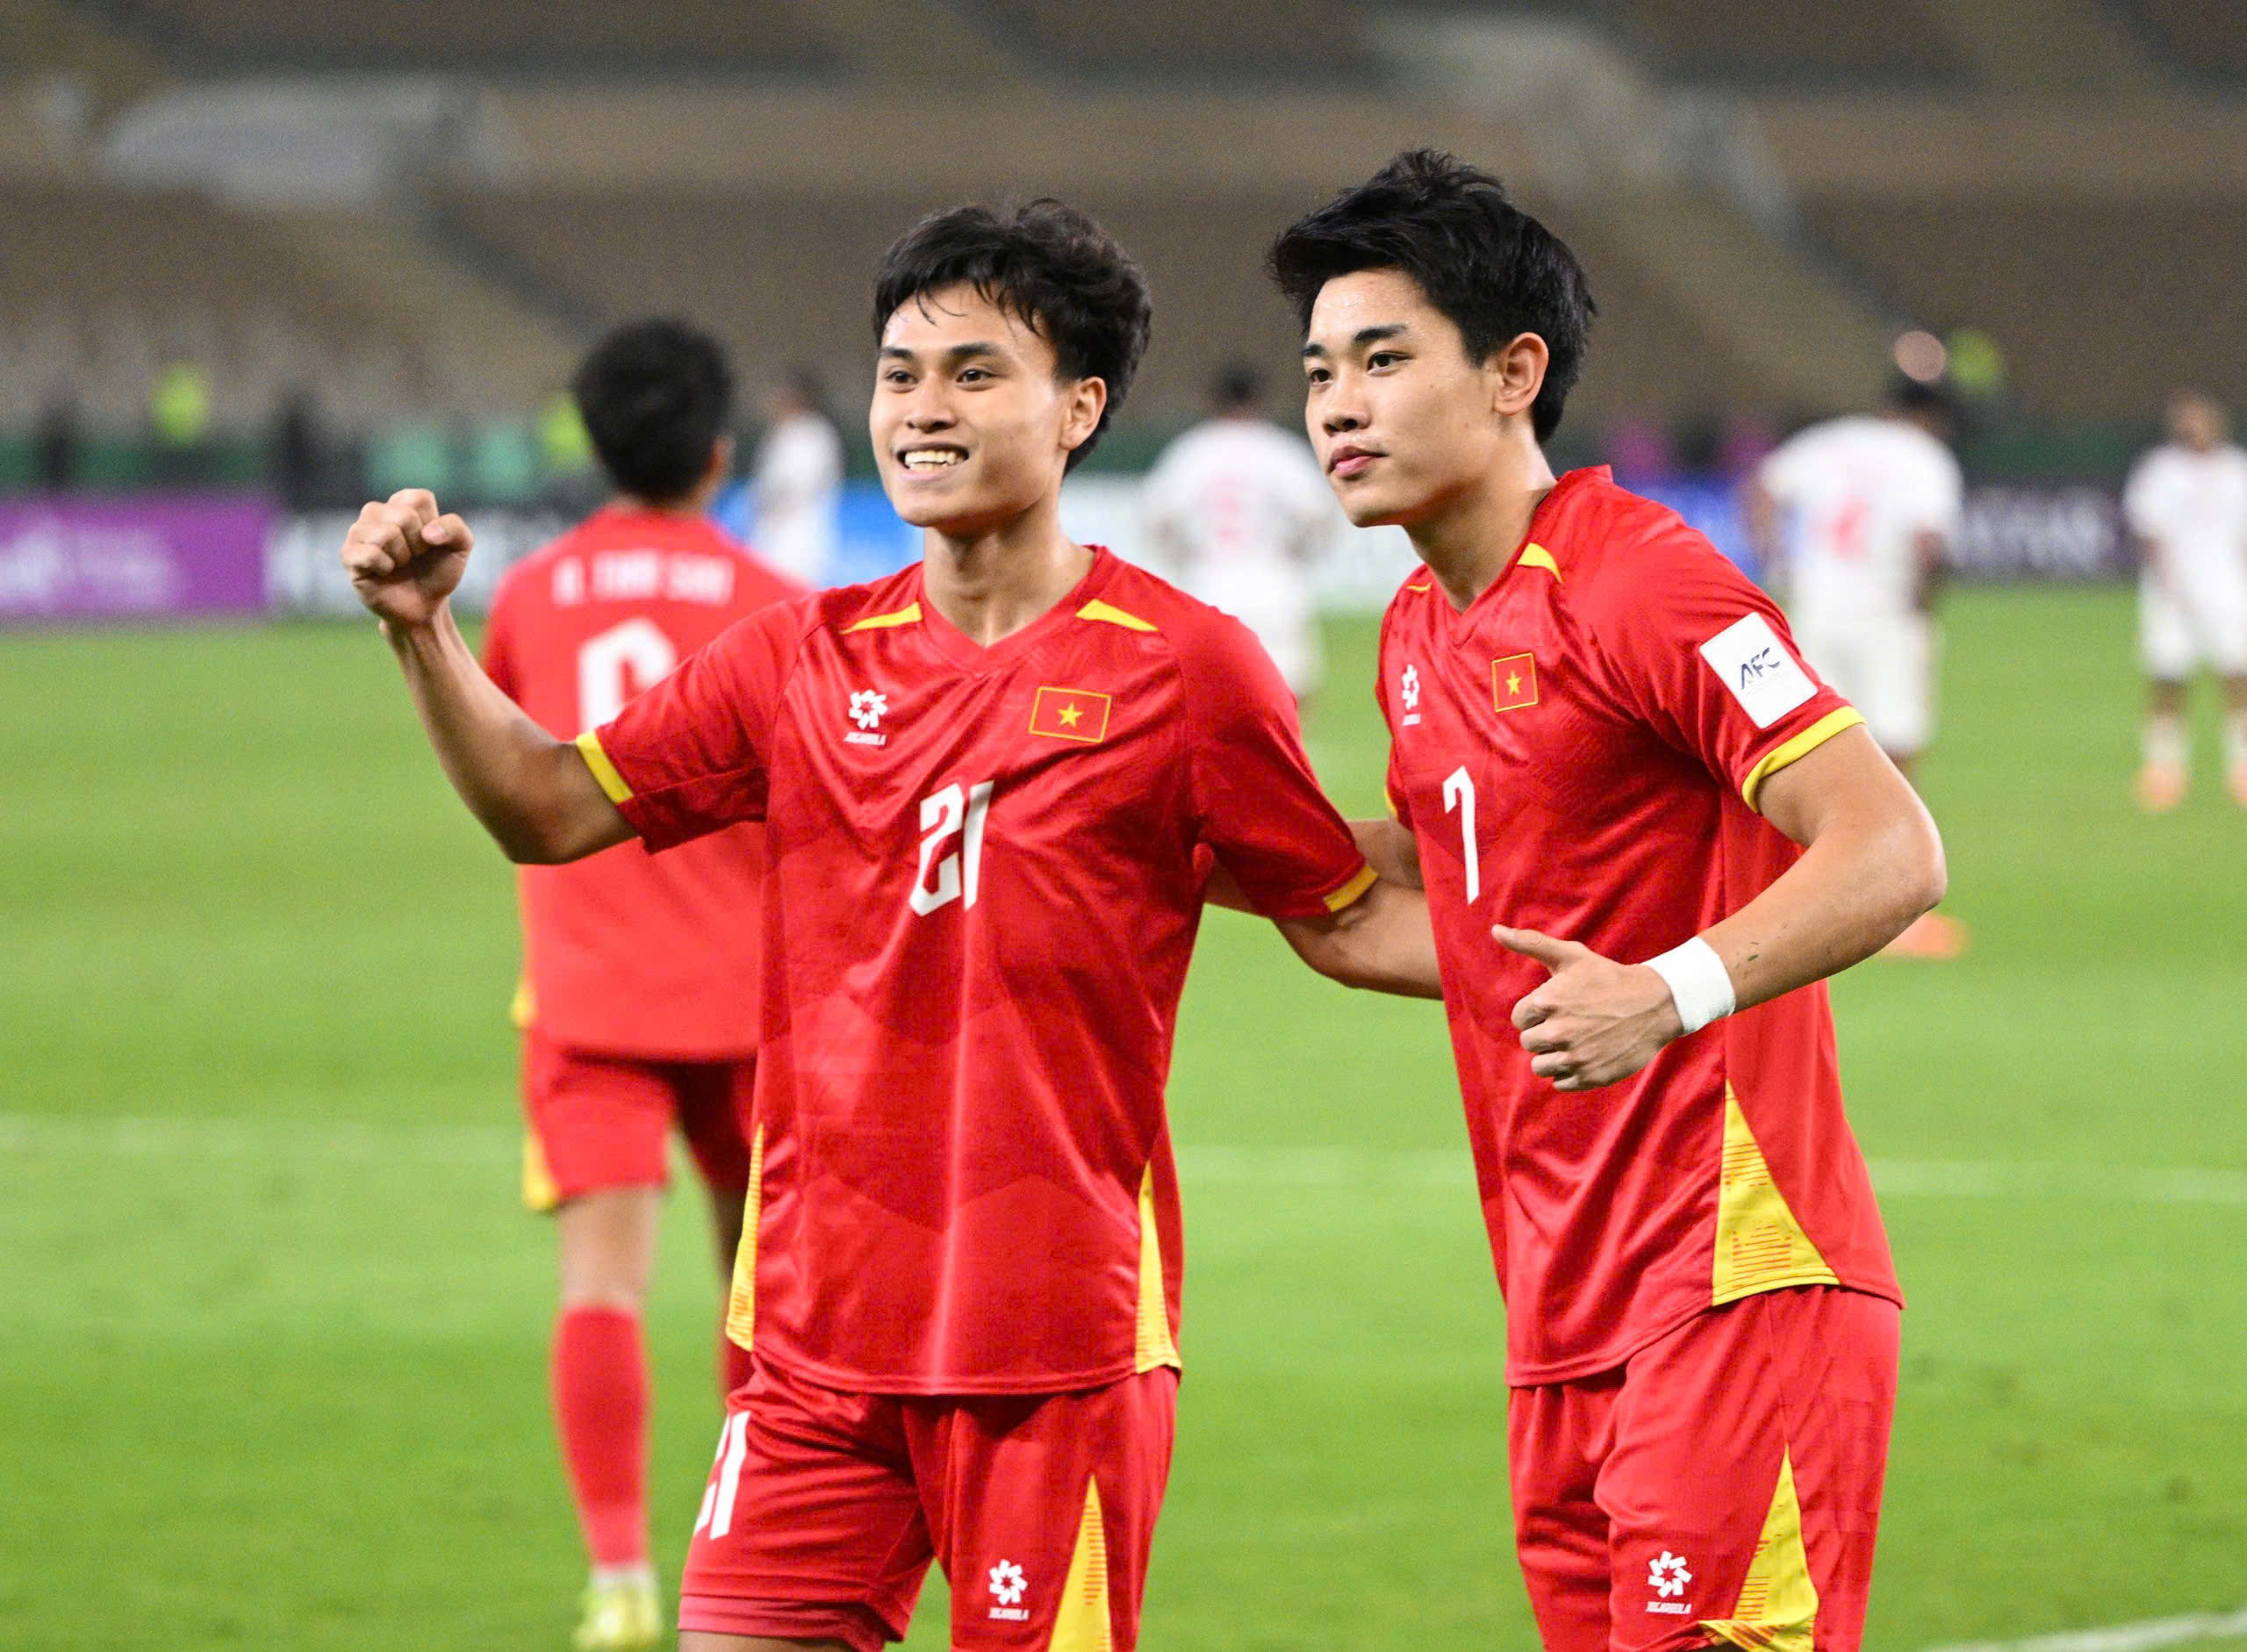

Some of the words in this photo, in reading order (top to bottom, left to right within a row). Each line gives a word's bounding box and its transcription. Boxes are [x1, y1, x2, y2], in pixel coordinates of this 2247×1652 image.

[1741, 646, 1781, 690] AFC
[909, 779, 995, 917] 21
[1442, 765, 1480, 906] 7
